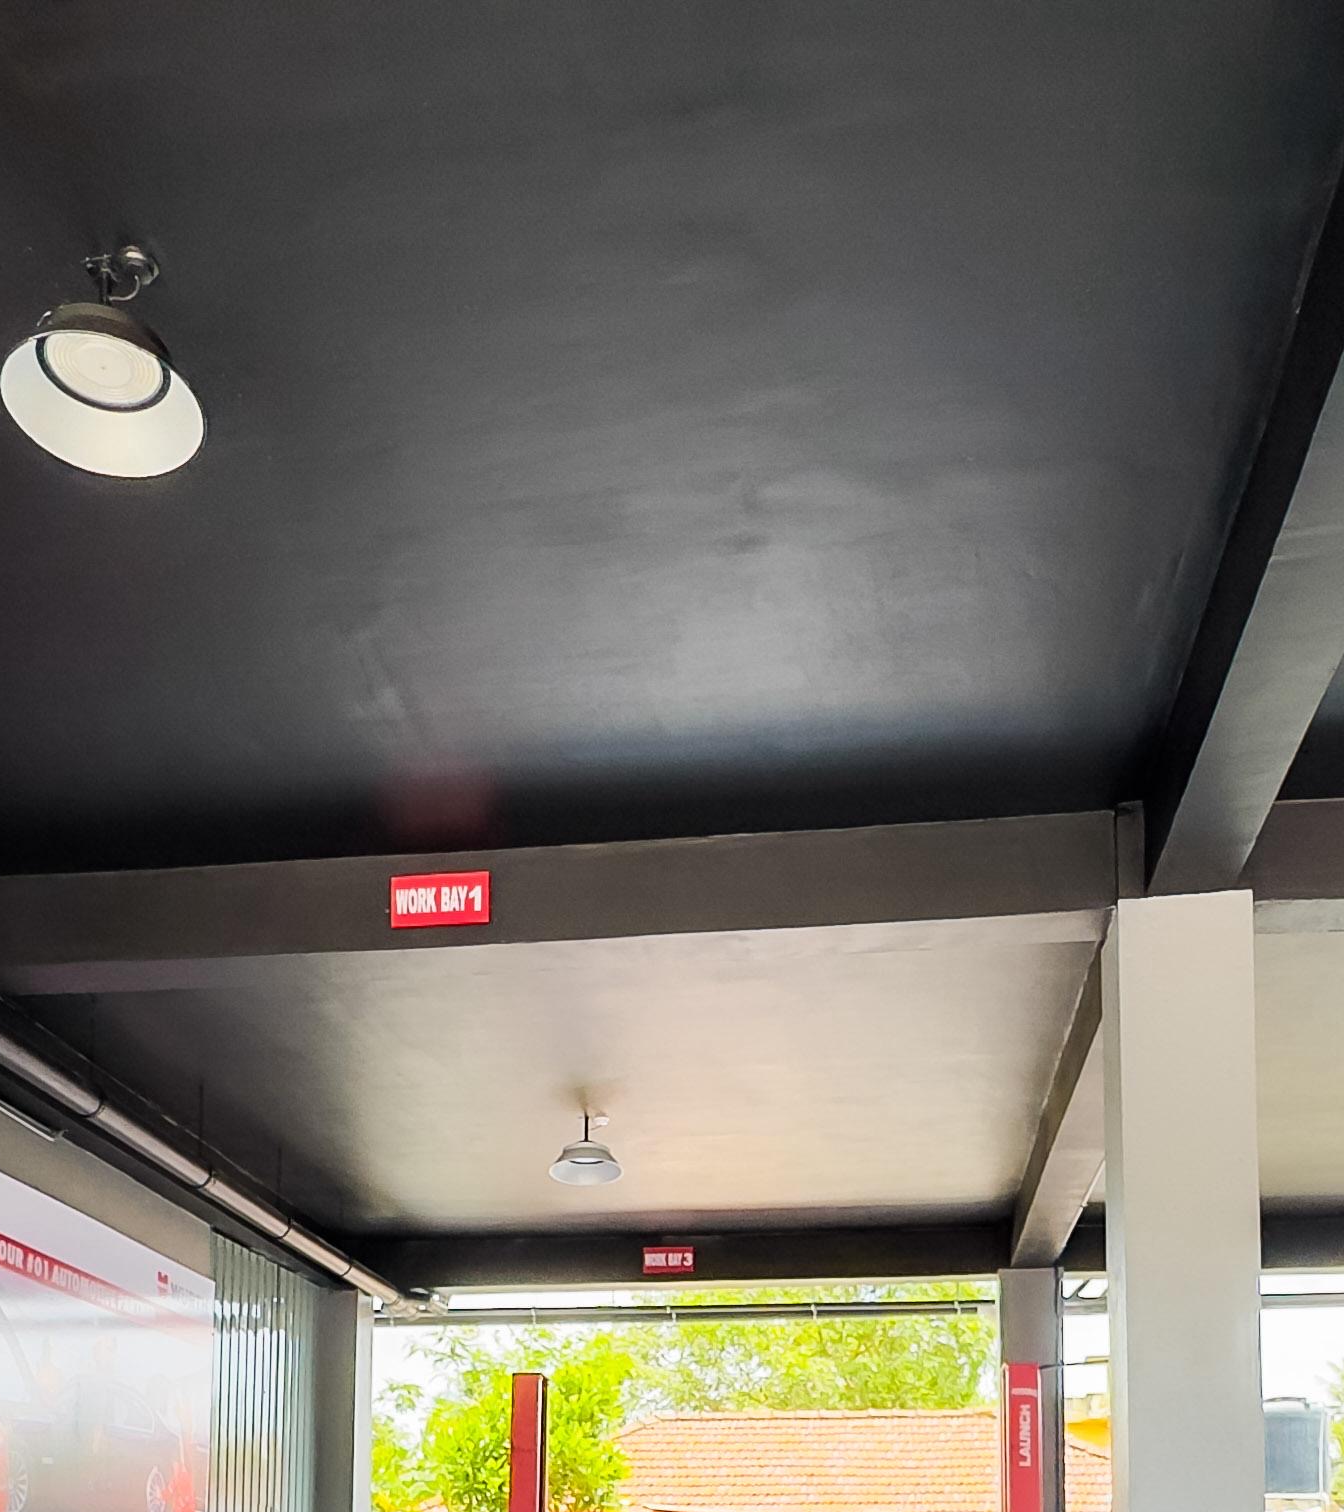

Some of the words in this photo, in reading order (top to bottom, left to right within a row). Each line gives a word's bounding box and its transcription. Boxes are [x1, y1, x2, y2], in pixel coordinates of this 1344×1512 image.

[395, 887, 437, 915] WORK
[441, 885, 468, 912] BAY
[469, 885, 482, 912] 1
[683, 1252, 693, 1267] 3
[1018, 1404, 1032, 1467] LAUNCH
